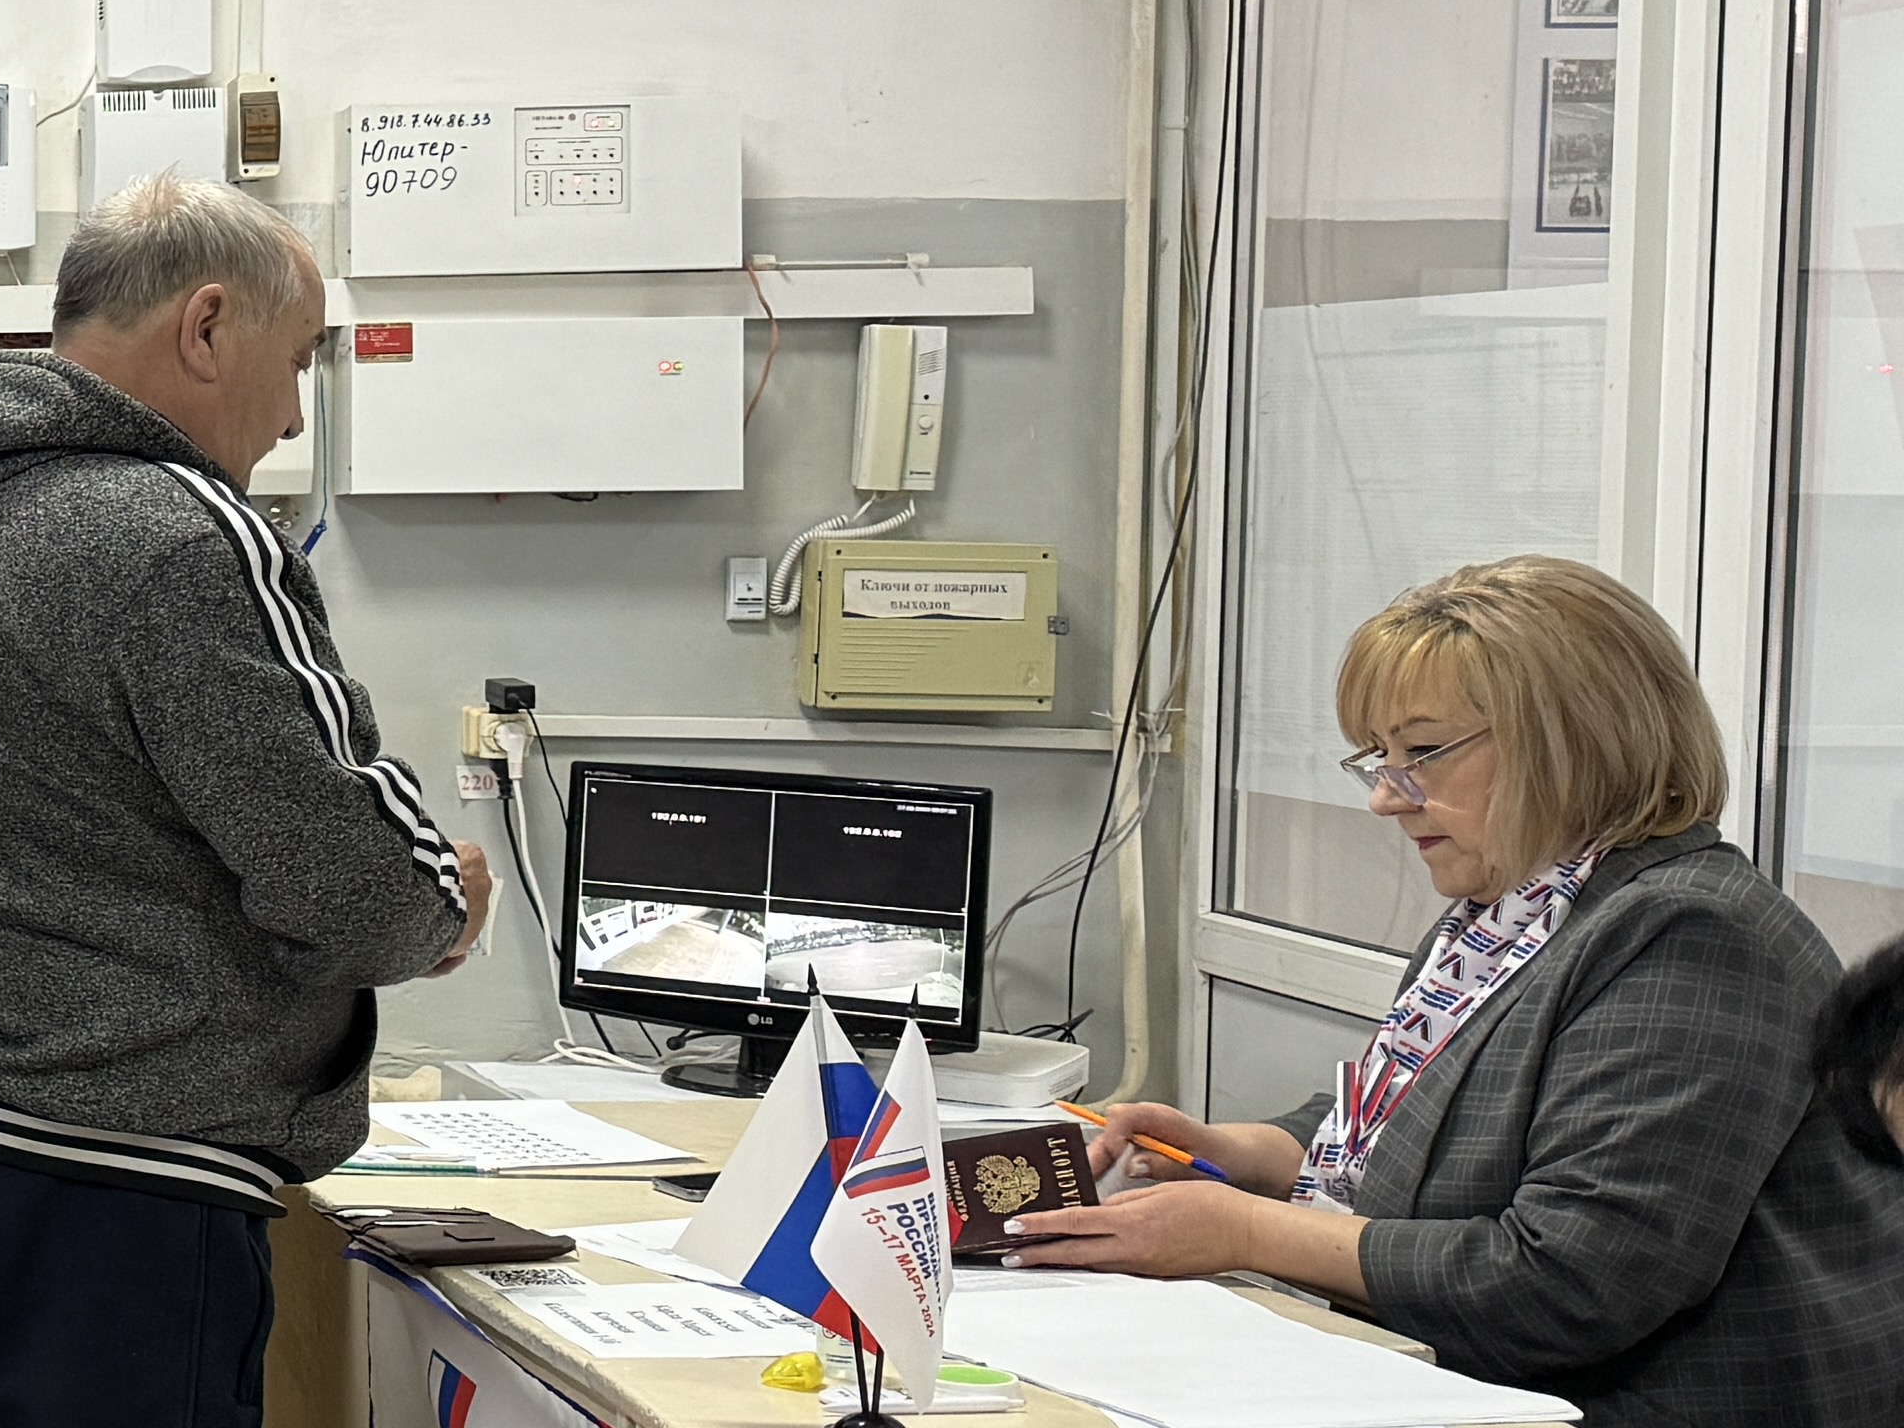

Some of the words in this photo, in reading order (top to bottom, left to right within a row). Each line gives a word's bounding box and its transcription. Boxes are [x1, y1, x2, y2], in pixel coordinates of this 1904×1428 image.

[366, 166, 457, 197] 90709
[860, 579, 910, 592] Ключи
[914, 582, 929, 592] от
[934, 583, 1008, 596] пожарных
[890, 600, 951, 611] выходов
[887, 1203, 932, 1279] РОССИИ
[896, 1253, 927, 1304] МАРТА
